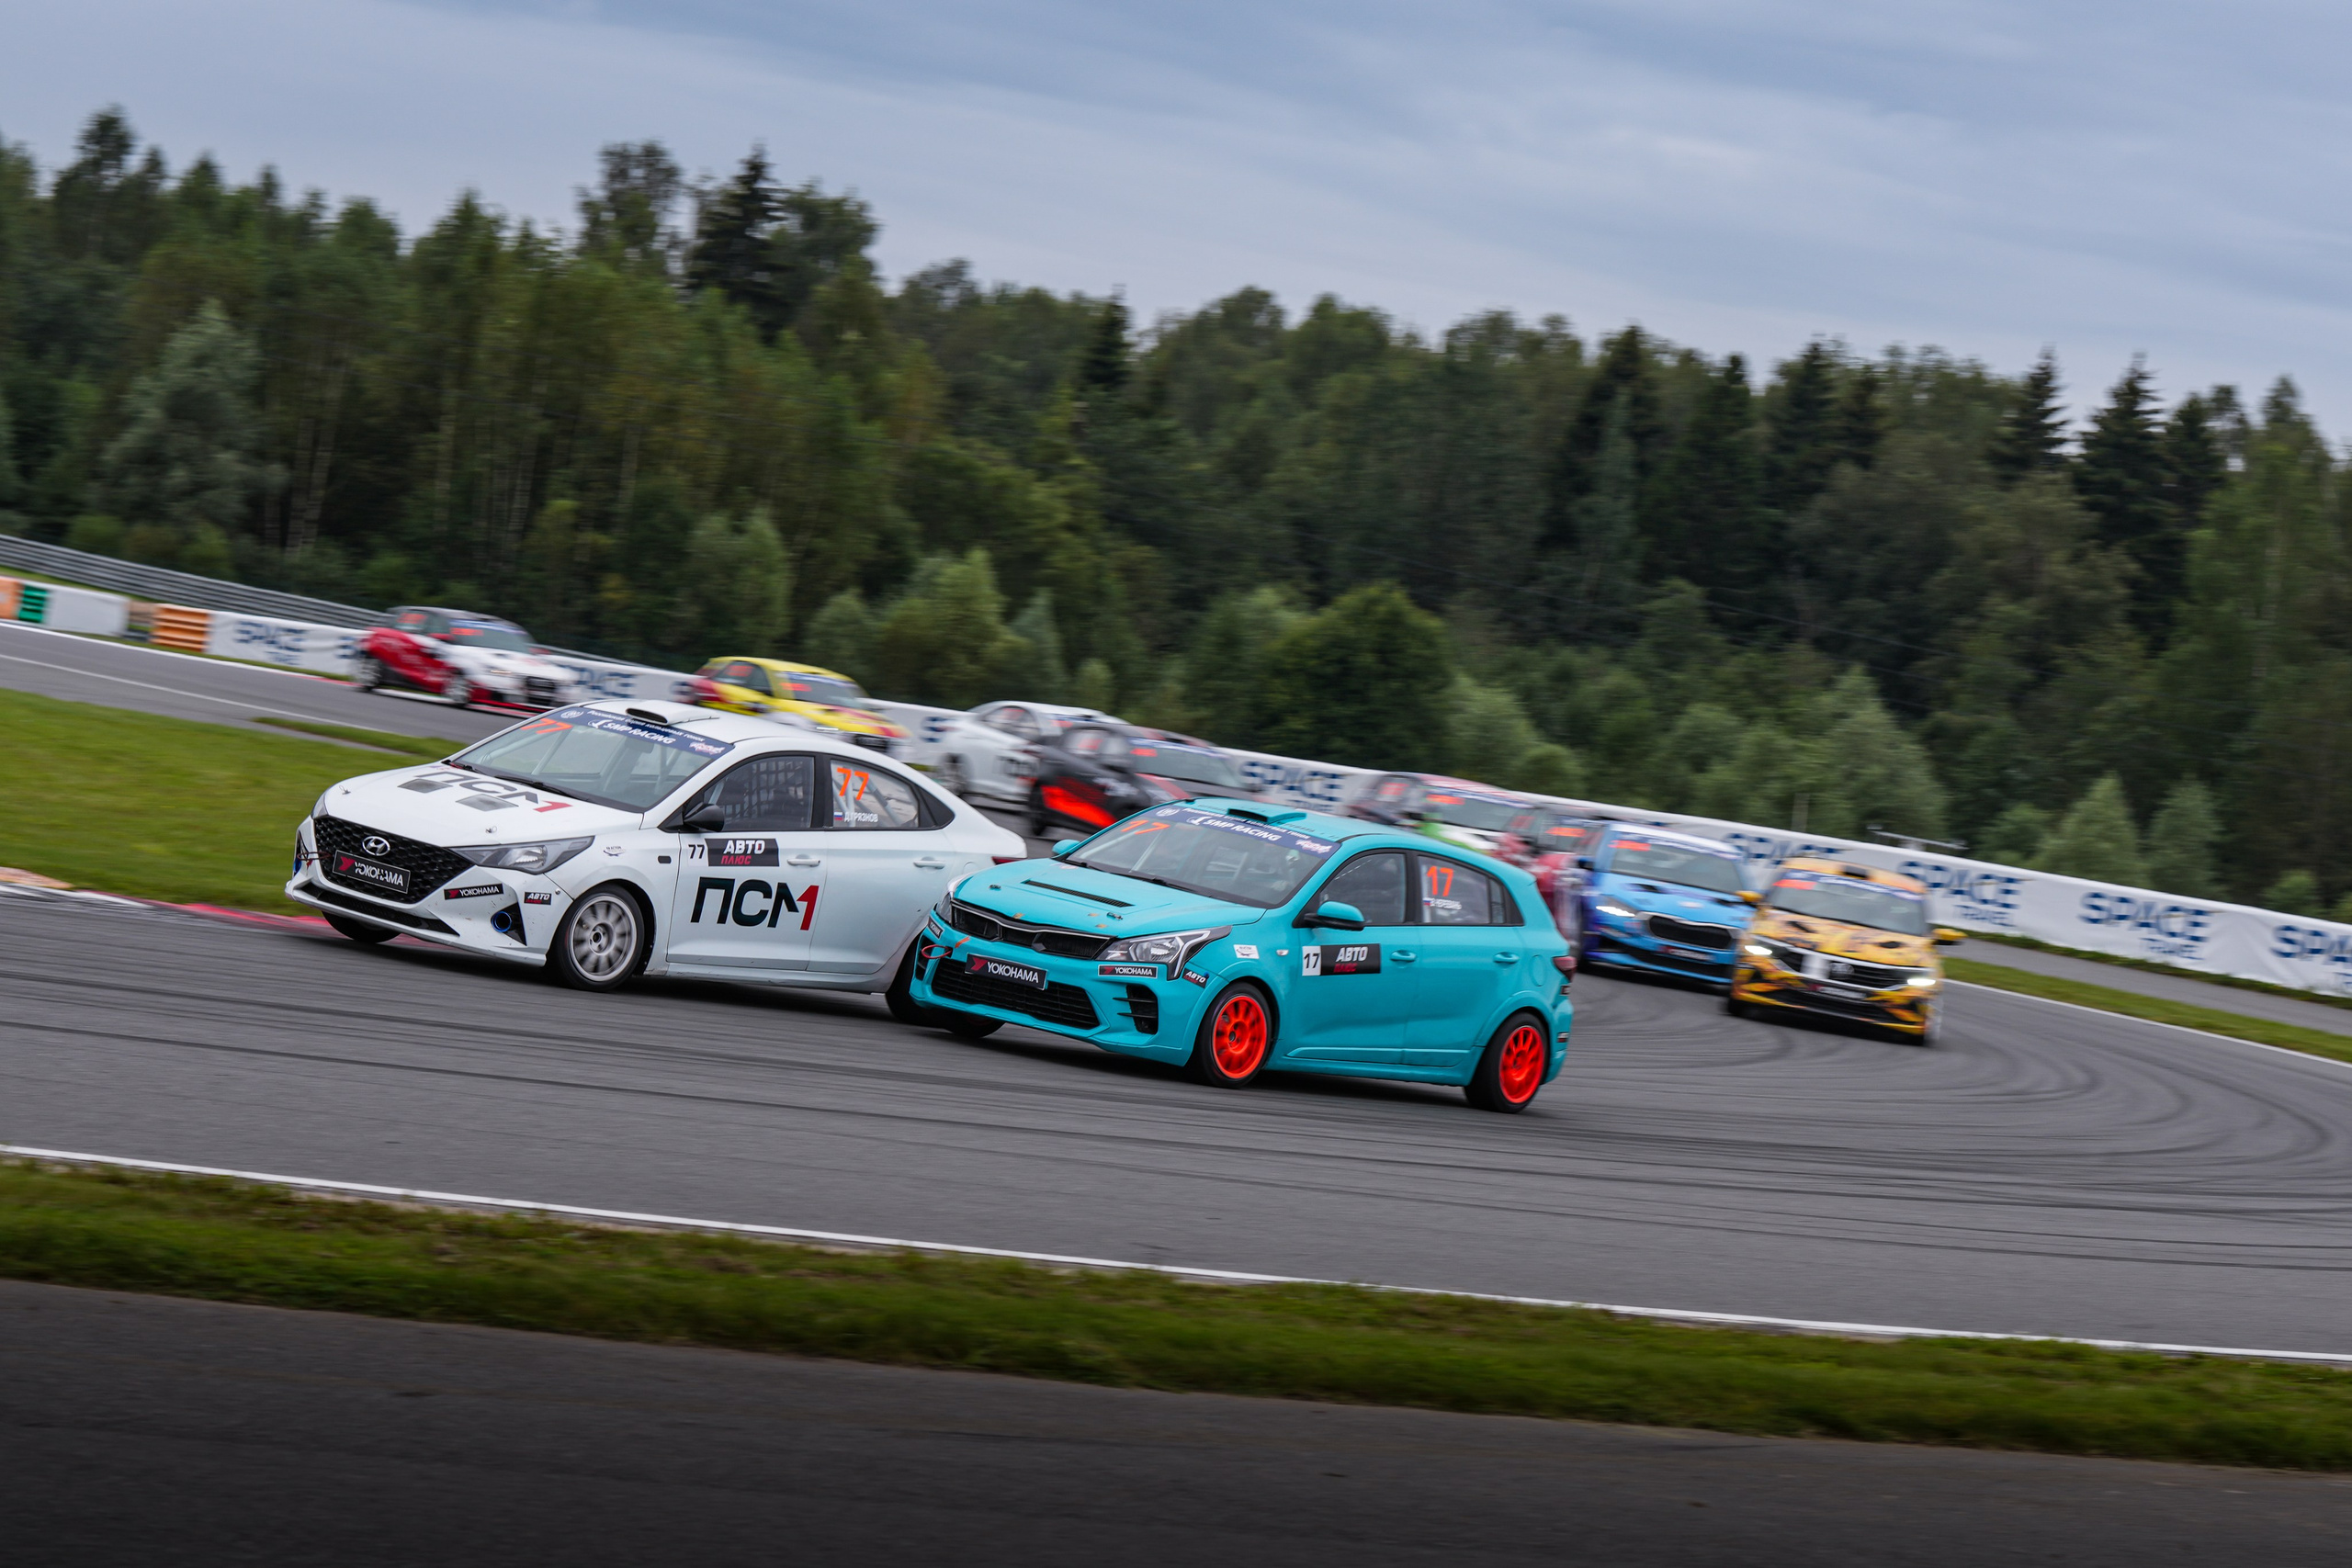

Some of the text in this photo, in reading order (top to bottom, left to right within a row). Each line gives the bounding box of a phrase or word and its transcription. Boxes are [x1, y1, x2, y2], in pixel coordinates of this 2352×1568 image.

[520, 717, 574, 735] 77
[603, 721, 676, 745] SMP RACING
[836, 767, 869, 801] 77
[1121, 819, 1170, 835] 17
[1203, 815, 1235, 829] SMP
[1231, 823, 1283, 841] RACING
[688, 844, 705, 859] 77
[723, 840, 765, 854] АВТО
[720, 855, 752, 864] ПЛЮС
[354, 861, 404, 887] YOKOHAMA
[1427, 865, 1454, 897] 17
[458, 886, 501, 897] YOKOHAMA
[526, 892, 550, 901] АВТО
[2078, 891, 2209, 942] SPACE
[1304, 953, 1320, 969] 17
[1335, 946, 1368, 963] АВТО
[987, 961, 1039, 984] YOKOHAMA
[1114, 966, 1153, 976] YOKOHAMA
[1185, 971, 1206, 983] АВТО
